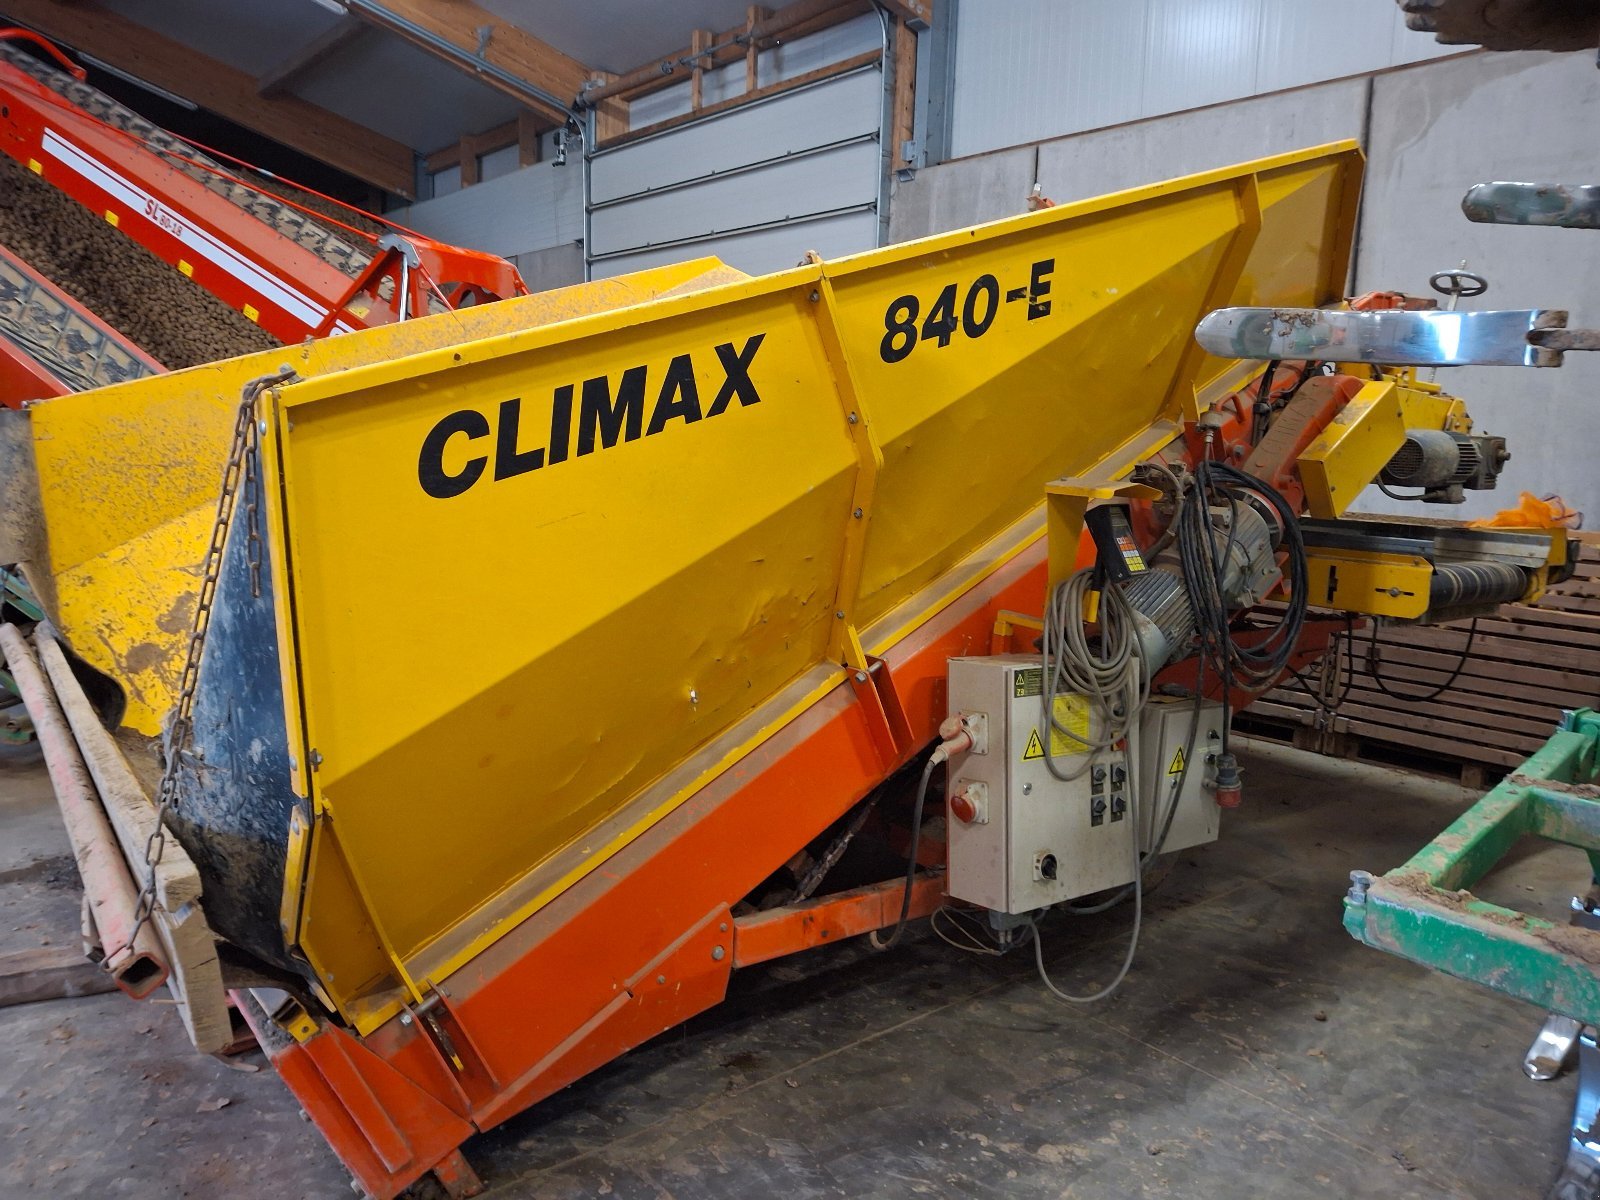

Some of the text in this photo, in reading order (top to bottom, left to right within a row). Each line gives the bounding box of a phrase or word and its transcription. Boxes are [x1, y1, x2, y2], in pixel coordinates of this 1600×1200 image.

[145, 199, 158, 221] SL
[879, 258, 1056, 364] 840-E
[417, 332, 767, 500] CLIMAX
